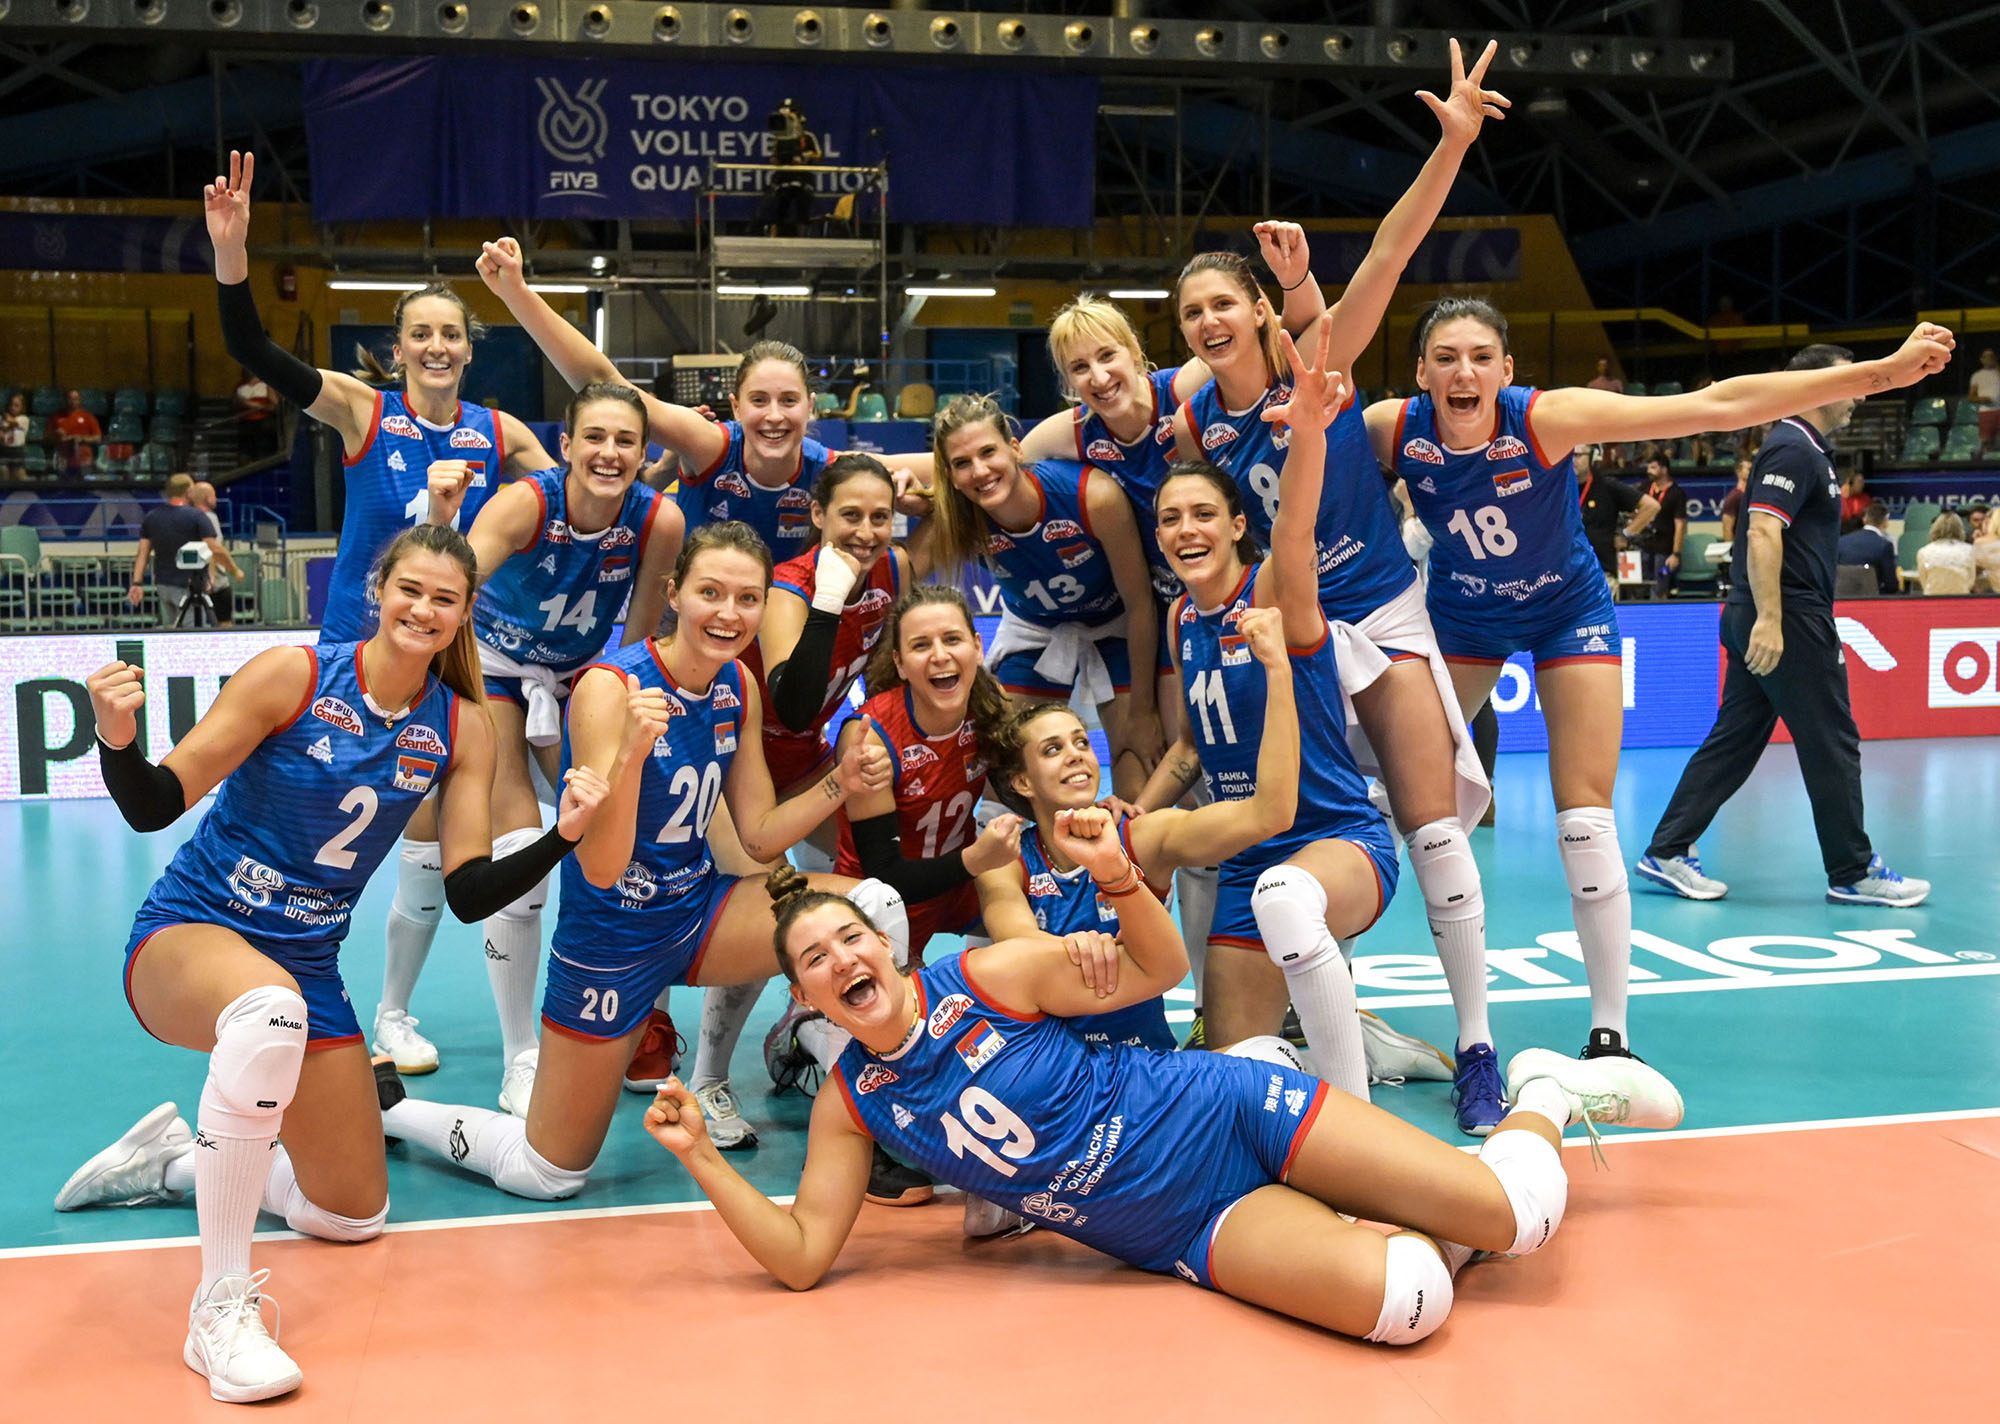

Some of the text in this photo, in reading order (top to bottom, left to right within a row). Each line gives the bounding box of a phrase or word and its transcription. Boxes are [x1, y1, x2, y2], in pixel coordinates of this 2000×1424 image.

[630, 94, 748, 122] TOKYO
[630, 130, 840, 158] VOLLEYBL
[550, 171, 598, 189] FIVB
[630, 165, 888, 193] QUALIFITION
[1406, 446, 1442, 464] Ganten
[1249, 463, 1280, 522] 8
[405, 489, 460, 532] 1
[1447, 505, 1518, 560] 18
[1024, 574, 1086, 611] 13
[539, 591, 597, 636] 14
[314, 703, 361, 735] Ganten
[1189, 669, 1238, 744] 11
[397, 734, 443, 755] Ganten
[394, 780, 427, 793] SERBIA
[656, 761, 721, 844] 20
[1221, 782, 1257, 794] ПОШТА
[313, 785, 379, 870] 2
[916, 791, 973, 858] 12
[227, 899, 254, 917] 1921
[620, 899, 643, 910] 1921
[579, 987, 619, 1022] 20
[932, 997, 973, 1037] Ganten
[971, 1039, 1006, 1071] SERBIA
[940, 1086, 1035, 1178] 19
